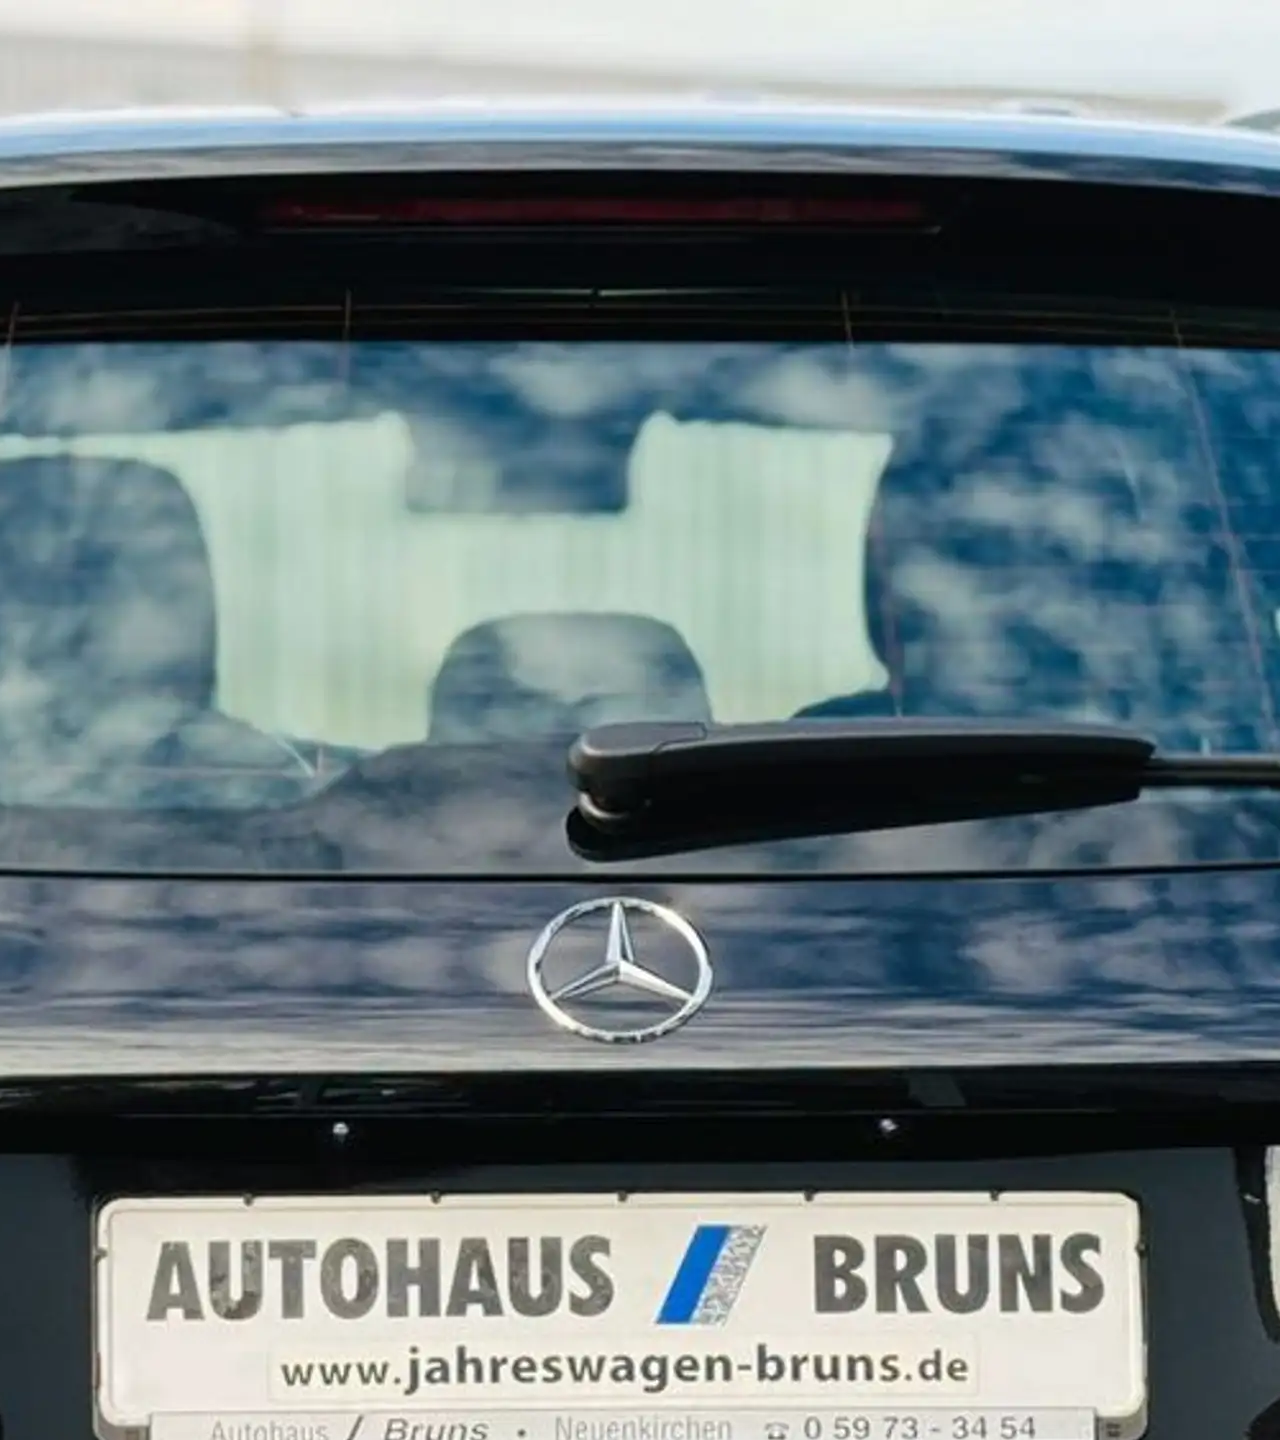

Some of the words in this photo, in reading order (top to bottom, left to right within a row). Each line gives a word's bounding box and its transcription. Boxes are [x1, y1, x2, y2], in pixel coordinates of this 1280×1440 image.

[146, 1235, 615, 1320] AUTOHAUS
[812, 1233, 1105, 1314] BRUNS
[281, 1344, 969, 1395] www.jahreswagen-bruns.de
[555, 1416, 732, 1440] Neuenkirchen
